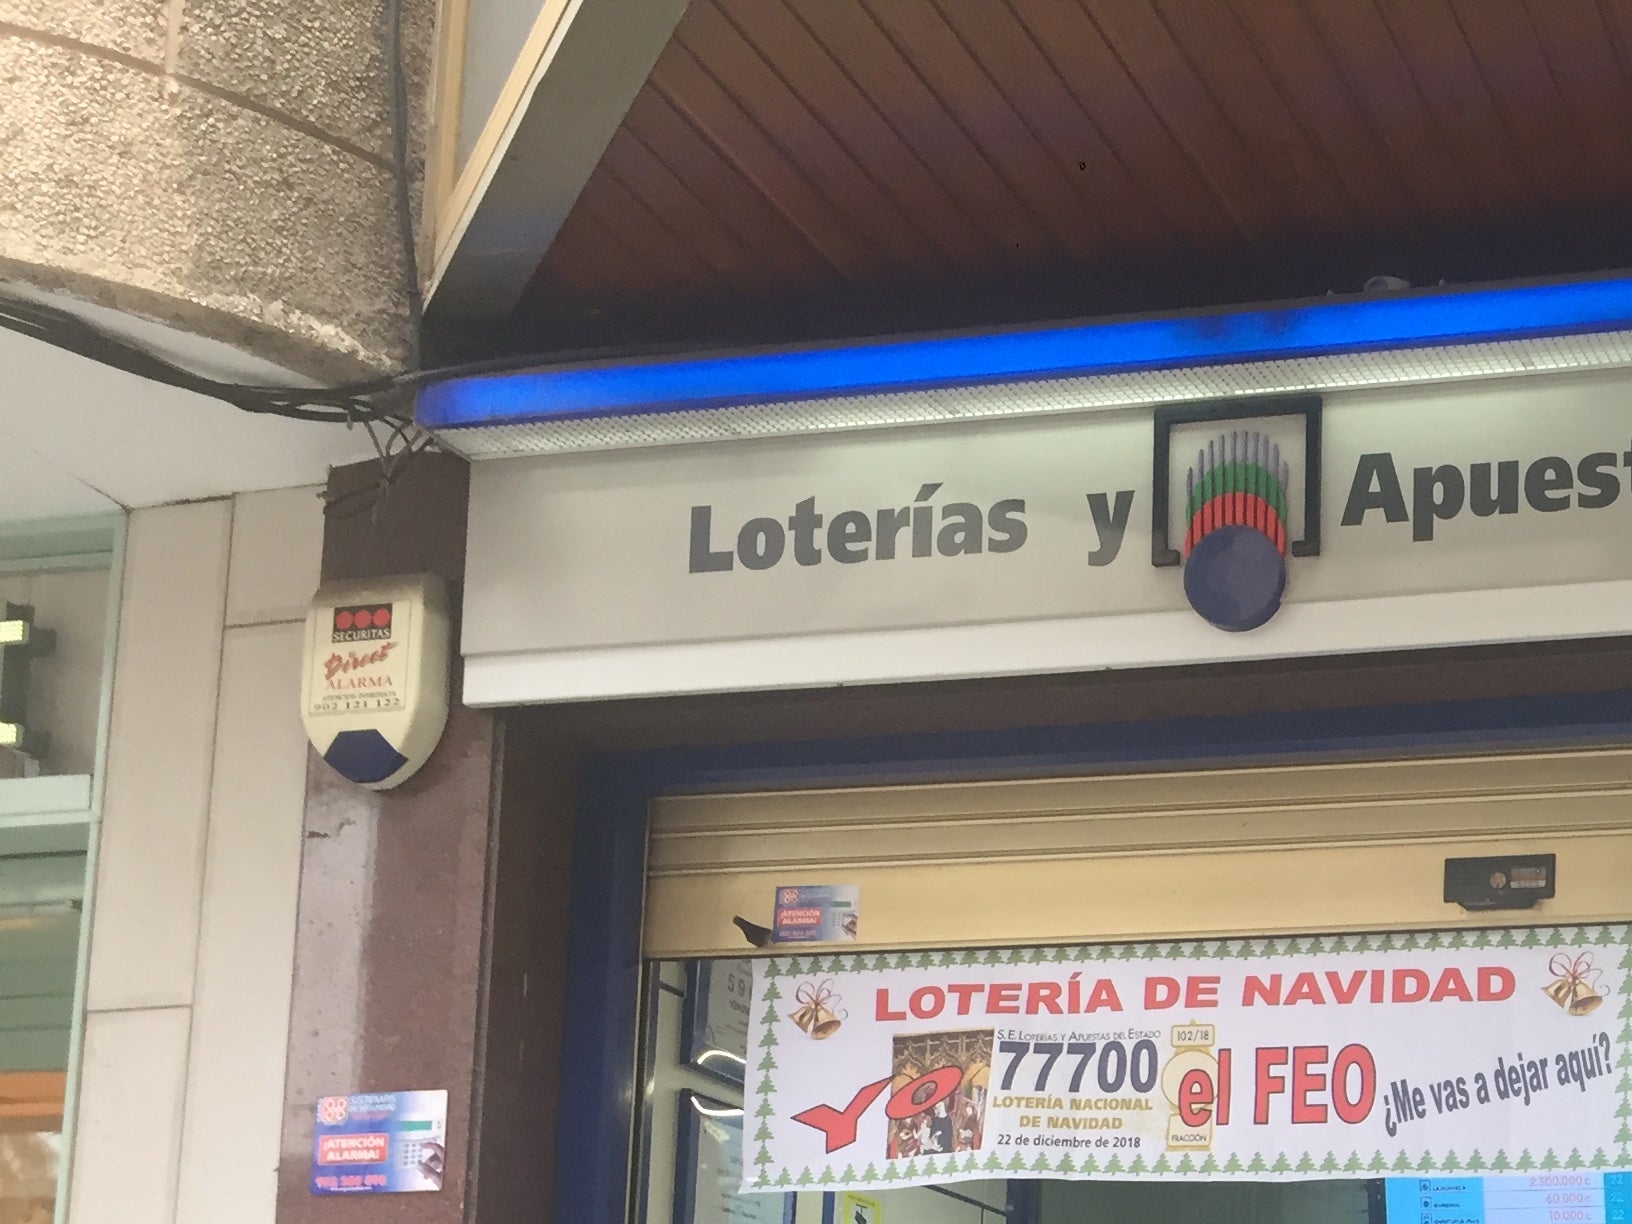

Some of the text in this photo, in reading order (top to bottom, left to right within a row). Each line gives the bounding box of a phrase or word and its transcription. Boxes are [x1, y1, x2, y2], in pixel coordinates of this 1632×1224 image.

[689, 483, 1027, 573] Loterías
[1087, 489, 1135, 566] y
[333, 628, 390, 642] SECURITAS
[327, 675, 393, 690] ALARMA
[873, 967, 1516, 1022] LOTERÍA DE NAVIDAD
[1177, 1030, 1210, 1043] 102/18
[998, 1039, 1158, 1094] 77700
[1178, 1043, 1376, 1128] el FEO
[1384, 1031, 1612, 1138] ¿Me vas a dejar aquí?
[992, 1094, 1153, 1112] LOTERÍA NACIONAL
[1019, 1115, 1123, 1130] DE NAVIDAD
[997, 1134, 1141, 1149] 22 de diciembre de 2018
